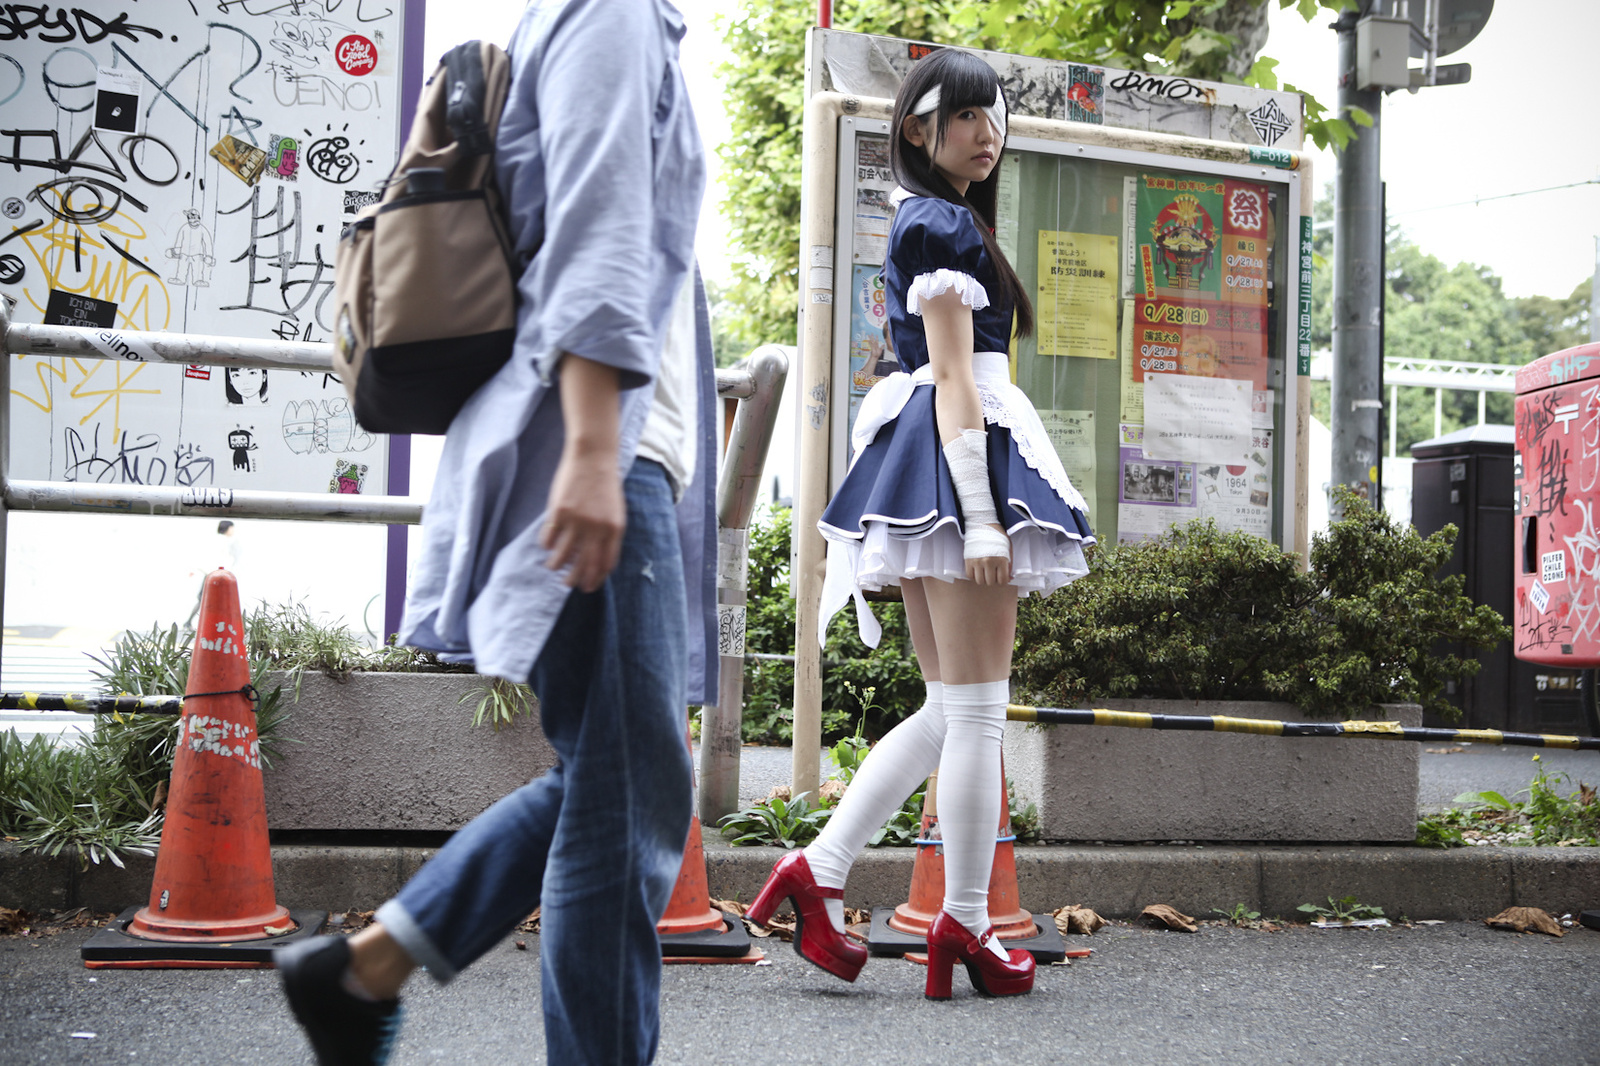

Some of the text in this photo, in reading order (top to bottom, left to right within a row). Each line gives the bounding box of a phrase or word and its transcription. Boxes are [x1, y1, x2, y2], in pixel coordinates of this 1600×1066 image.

[350, 40, 366, 51] The
[338, 42, 371, 63] Good
[345, 57, 375, 71] Company
[1231, 190, 1262, 229] 祭
[1051, 267, 1106, 279] 防災訓練
[1298, 240, 1313, 357] 神宮前三丁目22番
[73, 308, 88, 320] EIN
[1144, 303, 1209, 325] 9/28(日)
[1144, 330, 1181, 344] 演芸大会
[1141, 344, 1177, 356] 9/27(土)
[1140, 357, 1177, 371] 9/28(日)
[1252, 436, 1270, 449] 渋谷
[1226, 478, 1247, 489] 1964
[1543, 553, 1563, 564] PILFER
[1544, 562, 1562, 573] CHILE
[1543, 570, 1564, 581] OZONE
